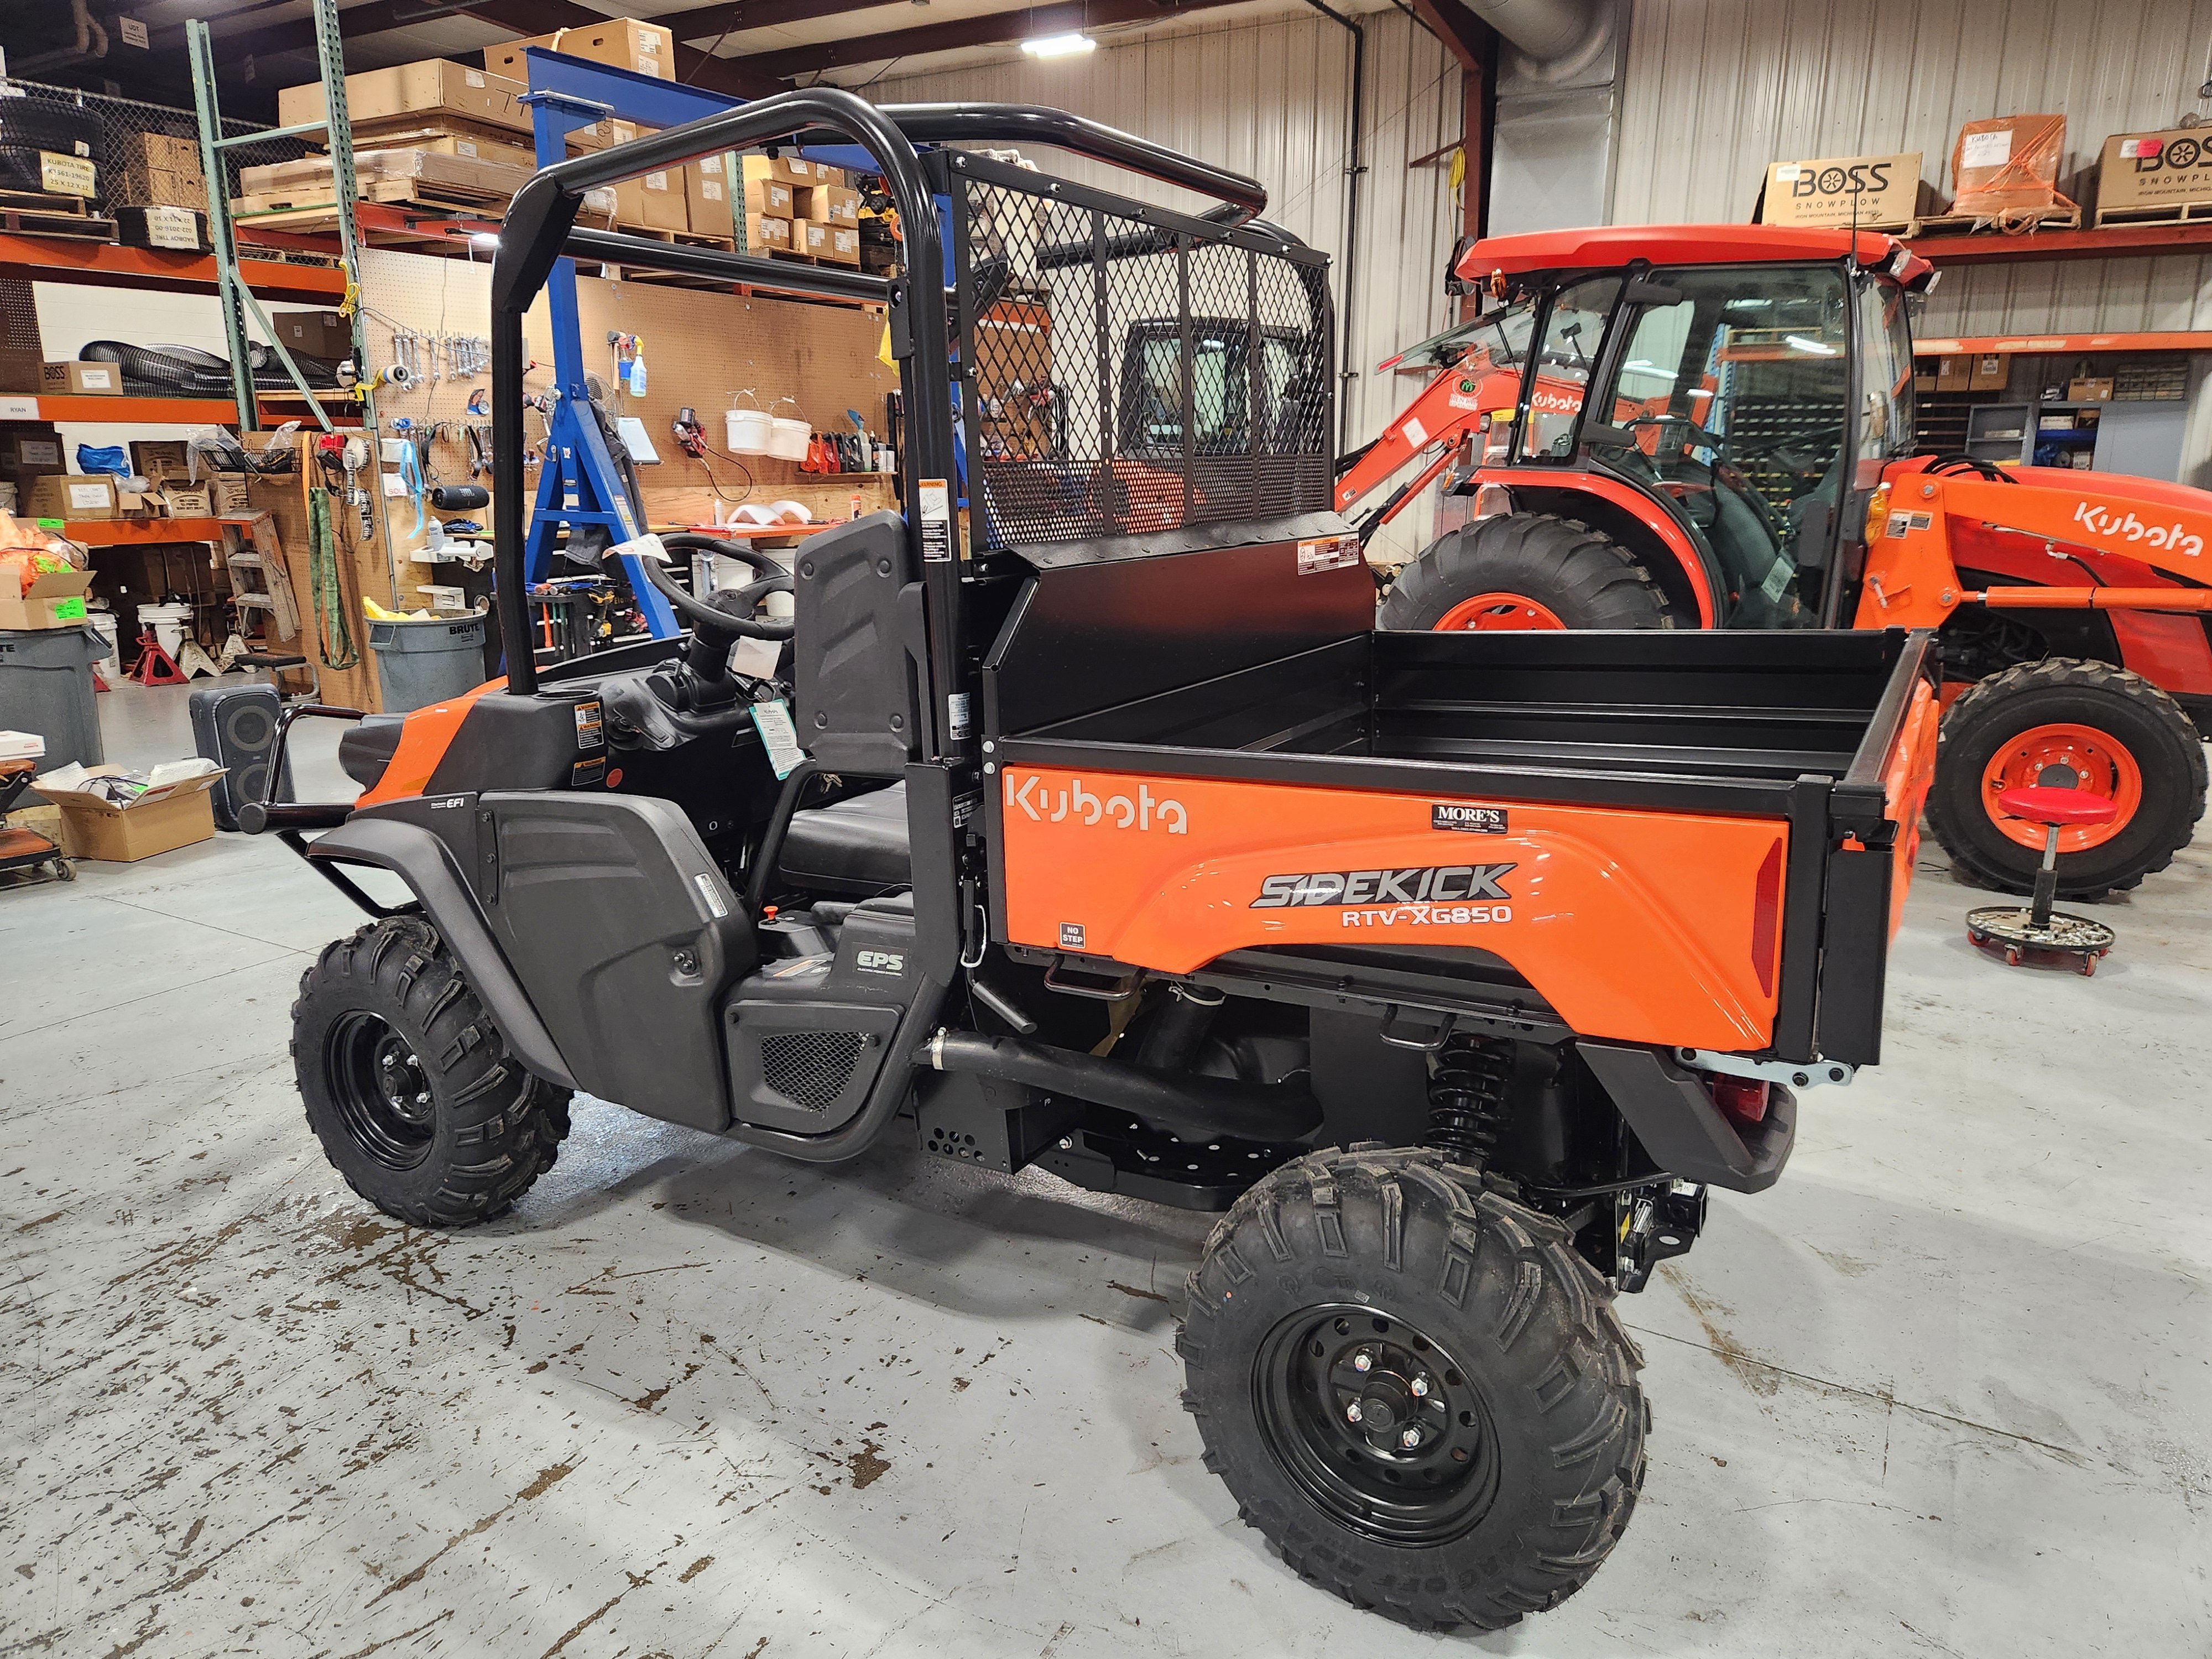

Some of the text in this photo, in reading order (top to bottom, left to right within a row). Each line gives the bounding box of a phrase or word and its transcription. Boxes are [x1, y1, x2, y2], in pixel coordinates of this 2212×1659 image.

[47, 158, 75, 169] KUBOTA
[1793, 163, 1891, 197] BOSS
[1796, 198, 1880, 210] SNOWPLOW
[44, 366, 65, 380] BOSS
[1531, 392, 1583, 412] Kubota
[460, 488, 475, 497] JBL
[2074, 502, 2204, 557] Kubota
[449, 623, 480, 635] BRUTE
[447, 797, 464, 808] EFI
[1006, 774, 1187, 834] Kubota
[1438, 807, 1500, 823] MORE'S
[1251, 864, 1516, 906] SIDEKICK
[1342, 905, 1512, 927] RTV-XG850
[1062, 934, 1083, 943] STEP
[857, 951, 903, 971] EPS
